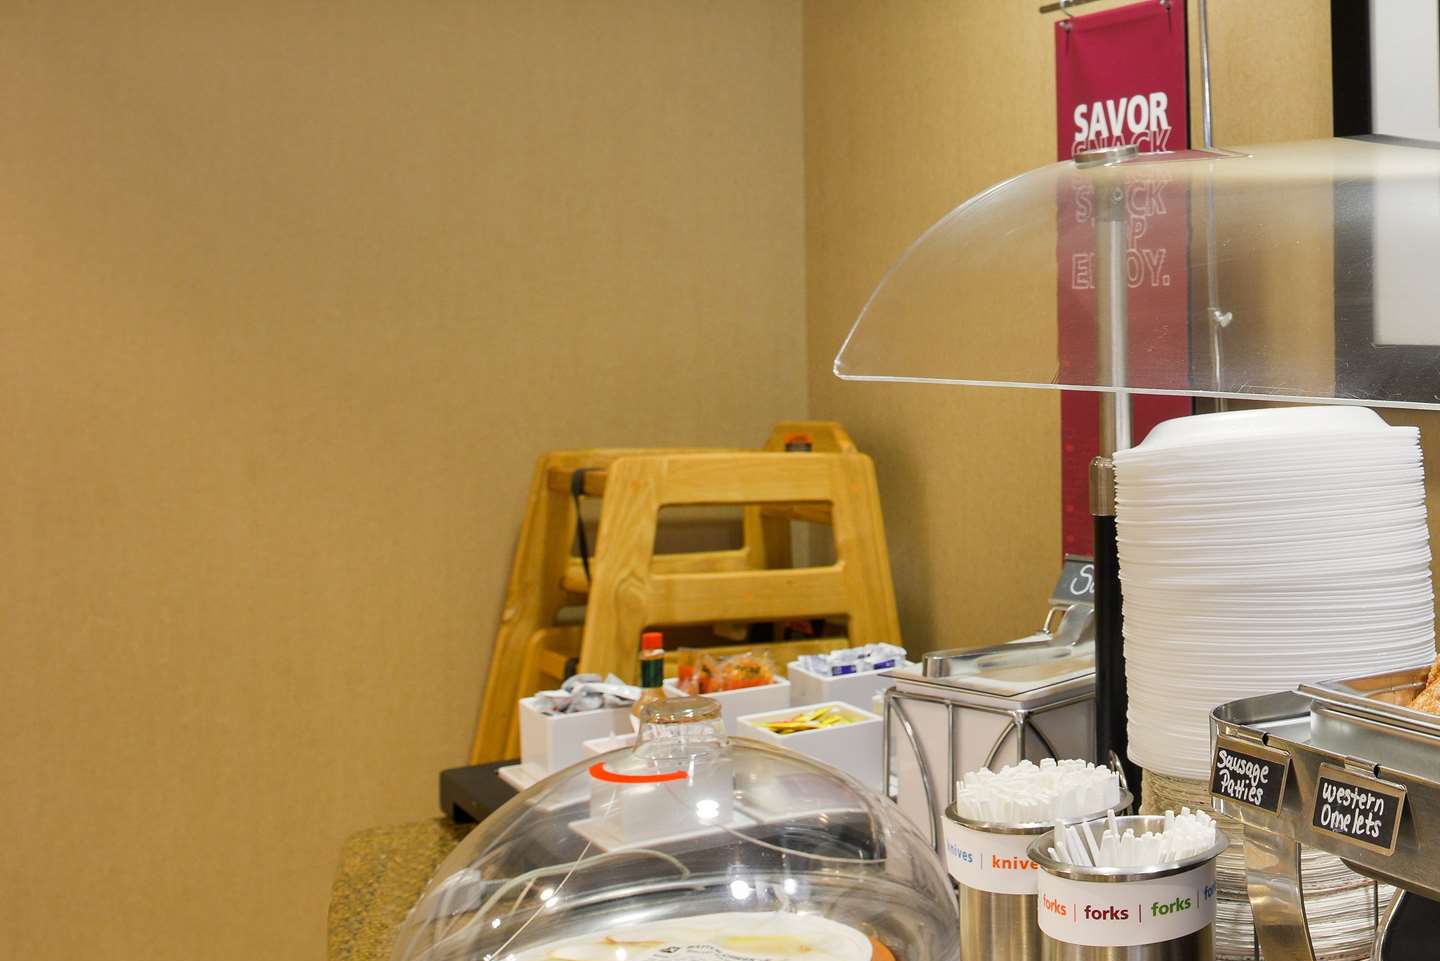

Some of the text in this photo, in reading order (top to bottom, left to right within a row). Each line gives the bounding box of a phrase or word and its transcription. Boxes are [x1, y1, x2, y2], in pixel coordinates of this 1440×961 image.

[1073, 92, 1171, 142] SAVOR
[1072, 248, 1170, 290] EOY.
[1217, 750, 1269, 787] Sausage
[1219, 769, 1263, 805] Patties
[1320, 804, 1382, 838] Omelets
[992, 854, 1039, 870] knive
[1043, 894, 1067, 916] forks
[1084, 905, 1129, 921] forks
[1151, 897, 1191, 917] forks
